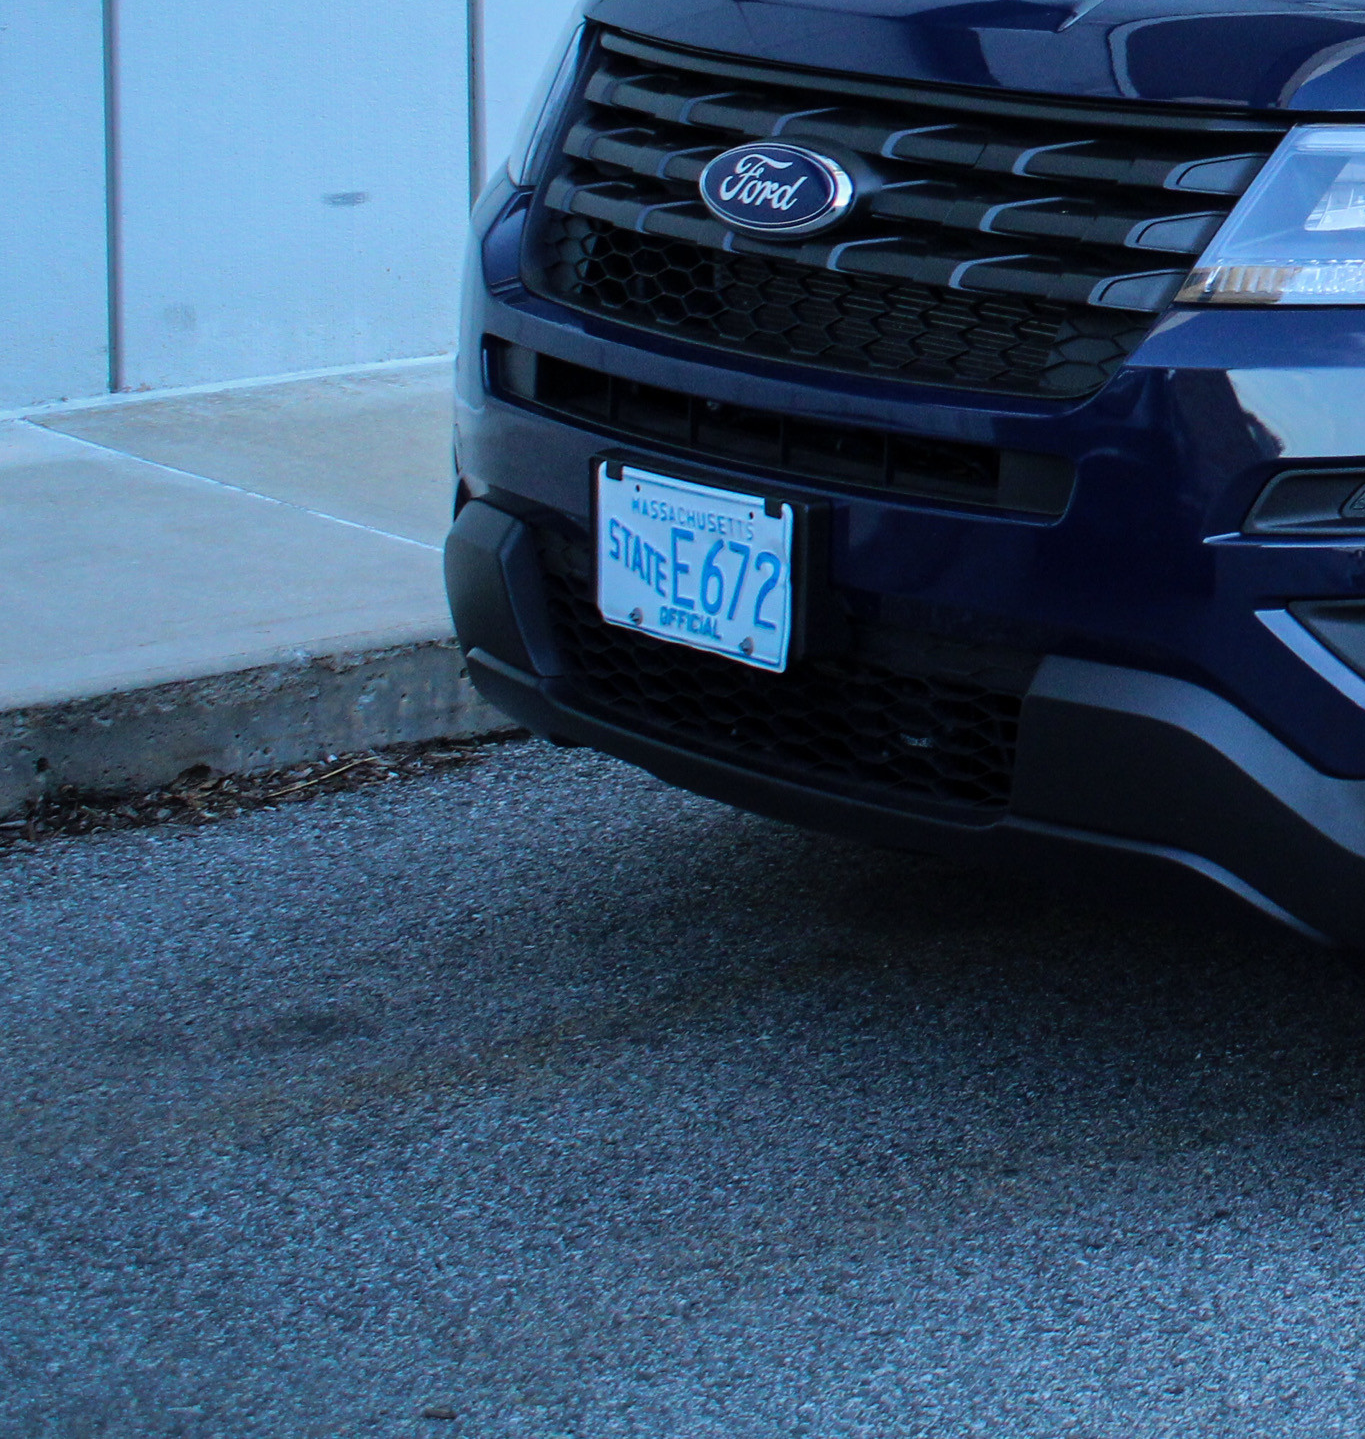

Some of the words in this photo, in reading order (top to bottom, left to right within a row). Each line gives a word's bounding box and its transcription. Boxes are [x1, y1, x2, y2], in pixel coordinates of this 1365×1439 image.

[719, 153, 808, 211] Ford
[631, 496, 755, 541] MASSACHUSETTS
[608, 517, 668, 597] STATE
[671, 526, 783, 631] E672
[658, 605, 723, 641] OFFICIAL
